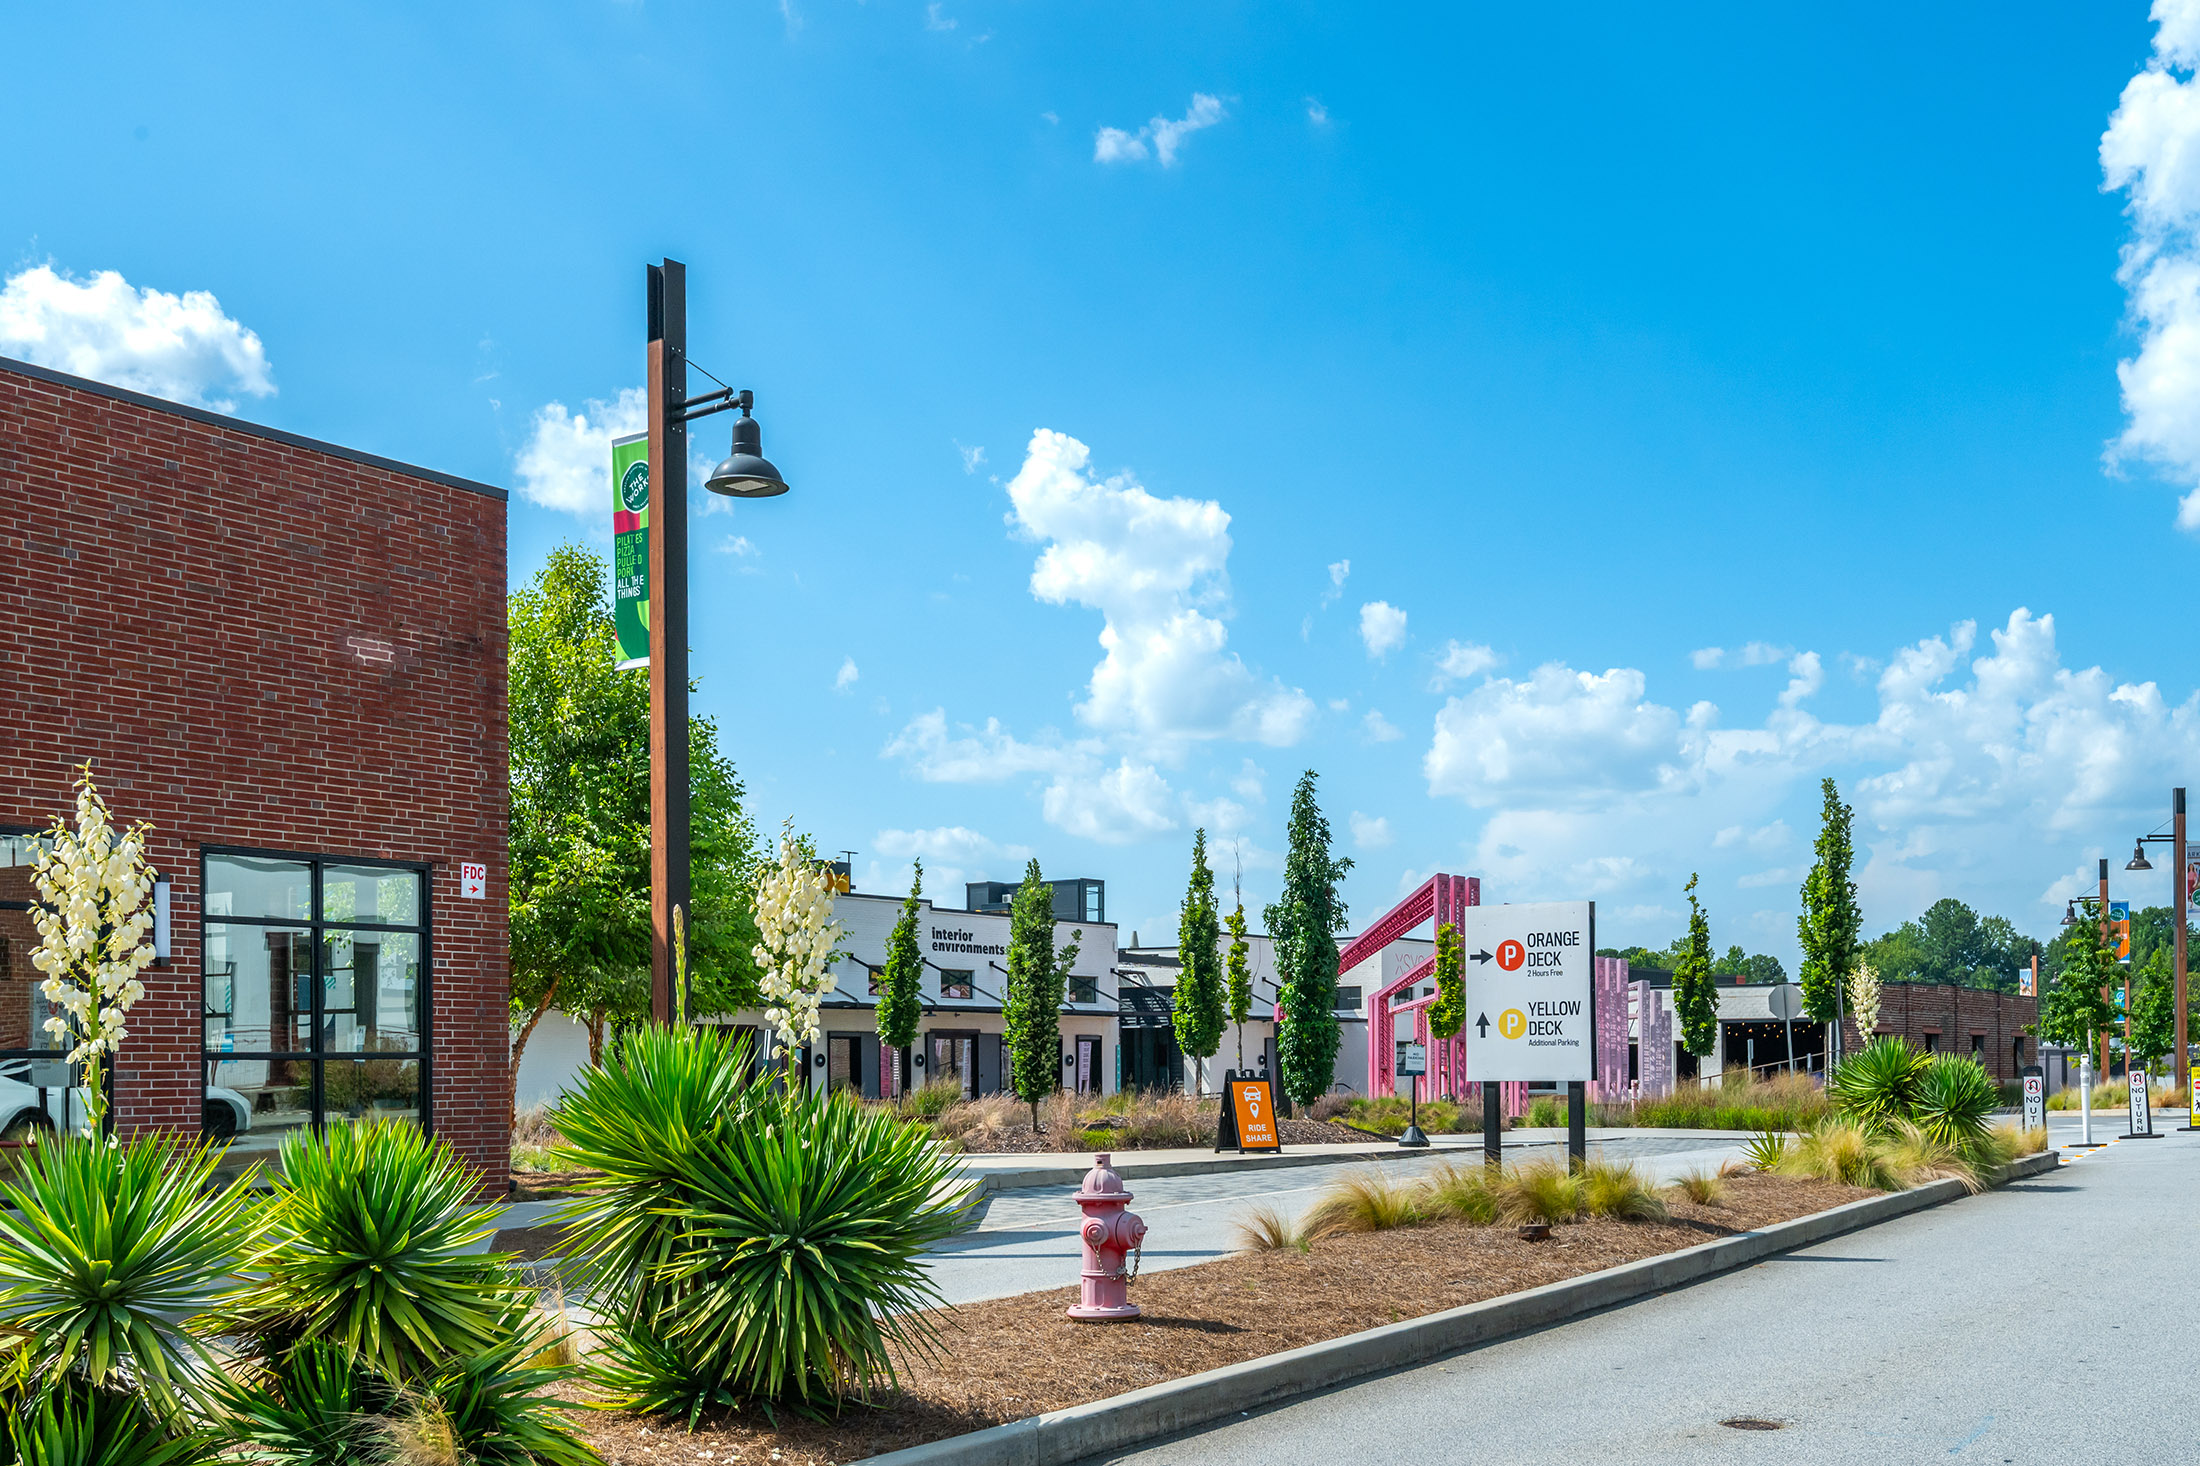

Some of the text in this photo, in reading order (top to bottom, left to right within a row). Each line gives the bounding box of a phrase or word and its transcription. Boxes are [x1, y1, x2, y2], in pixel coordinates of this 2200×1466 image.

[625, 475, 649, 504] WORK
[629, 472, 644, 491] THE
[616, 565, 634, 579] PORK
[617, 574, 645, 590] ALL THE
[617, 585, 641, 600] THINGS
[463, 865, 485, 881] FDC
[931, 926, 974, 941] interior
[1527, 931, 1580, 948] ORANGE
[931, 941, 1006, 956] environments
[1504, 945, 1517, 967] P
[1527, 951, 1562, 968] DECK
[1527, 970, 1532, 978] 2
[1550, 969, 1564, 977] Free
[1528, 1000, 1581, 1017] YELLOW
[1506, 1013, 1519, 1035] P
[1529, 1020, 1563, 1036] DECK
[1528, 1039, 1580, 1047] Additional Parking
[2025, 1096, 2041, 1104] NO
[1248, 1123, 1267, 1132] RIDE
[1246, 1134, 1273, 1143] SHARE
